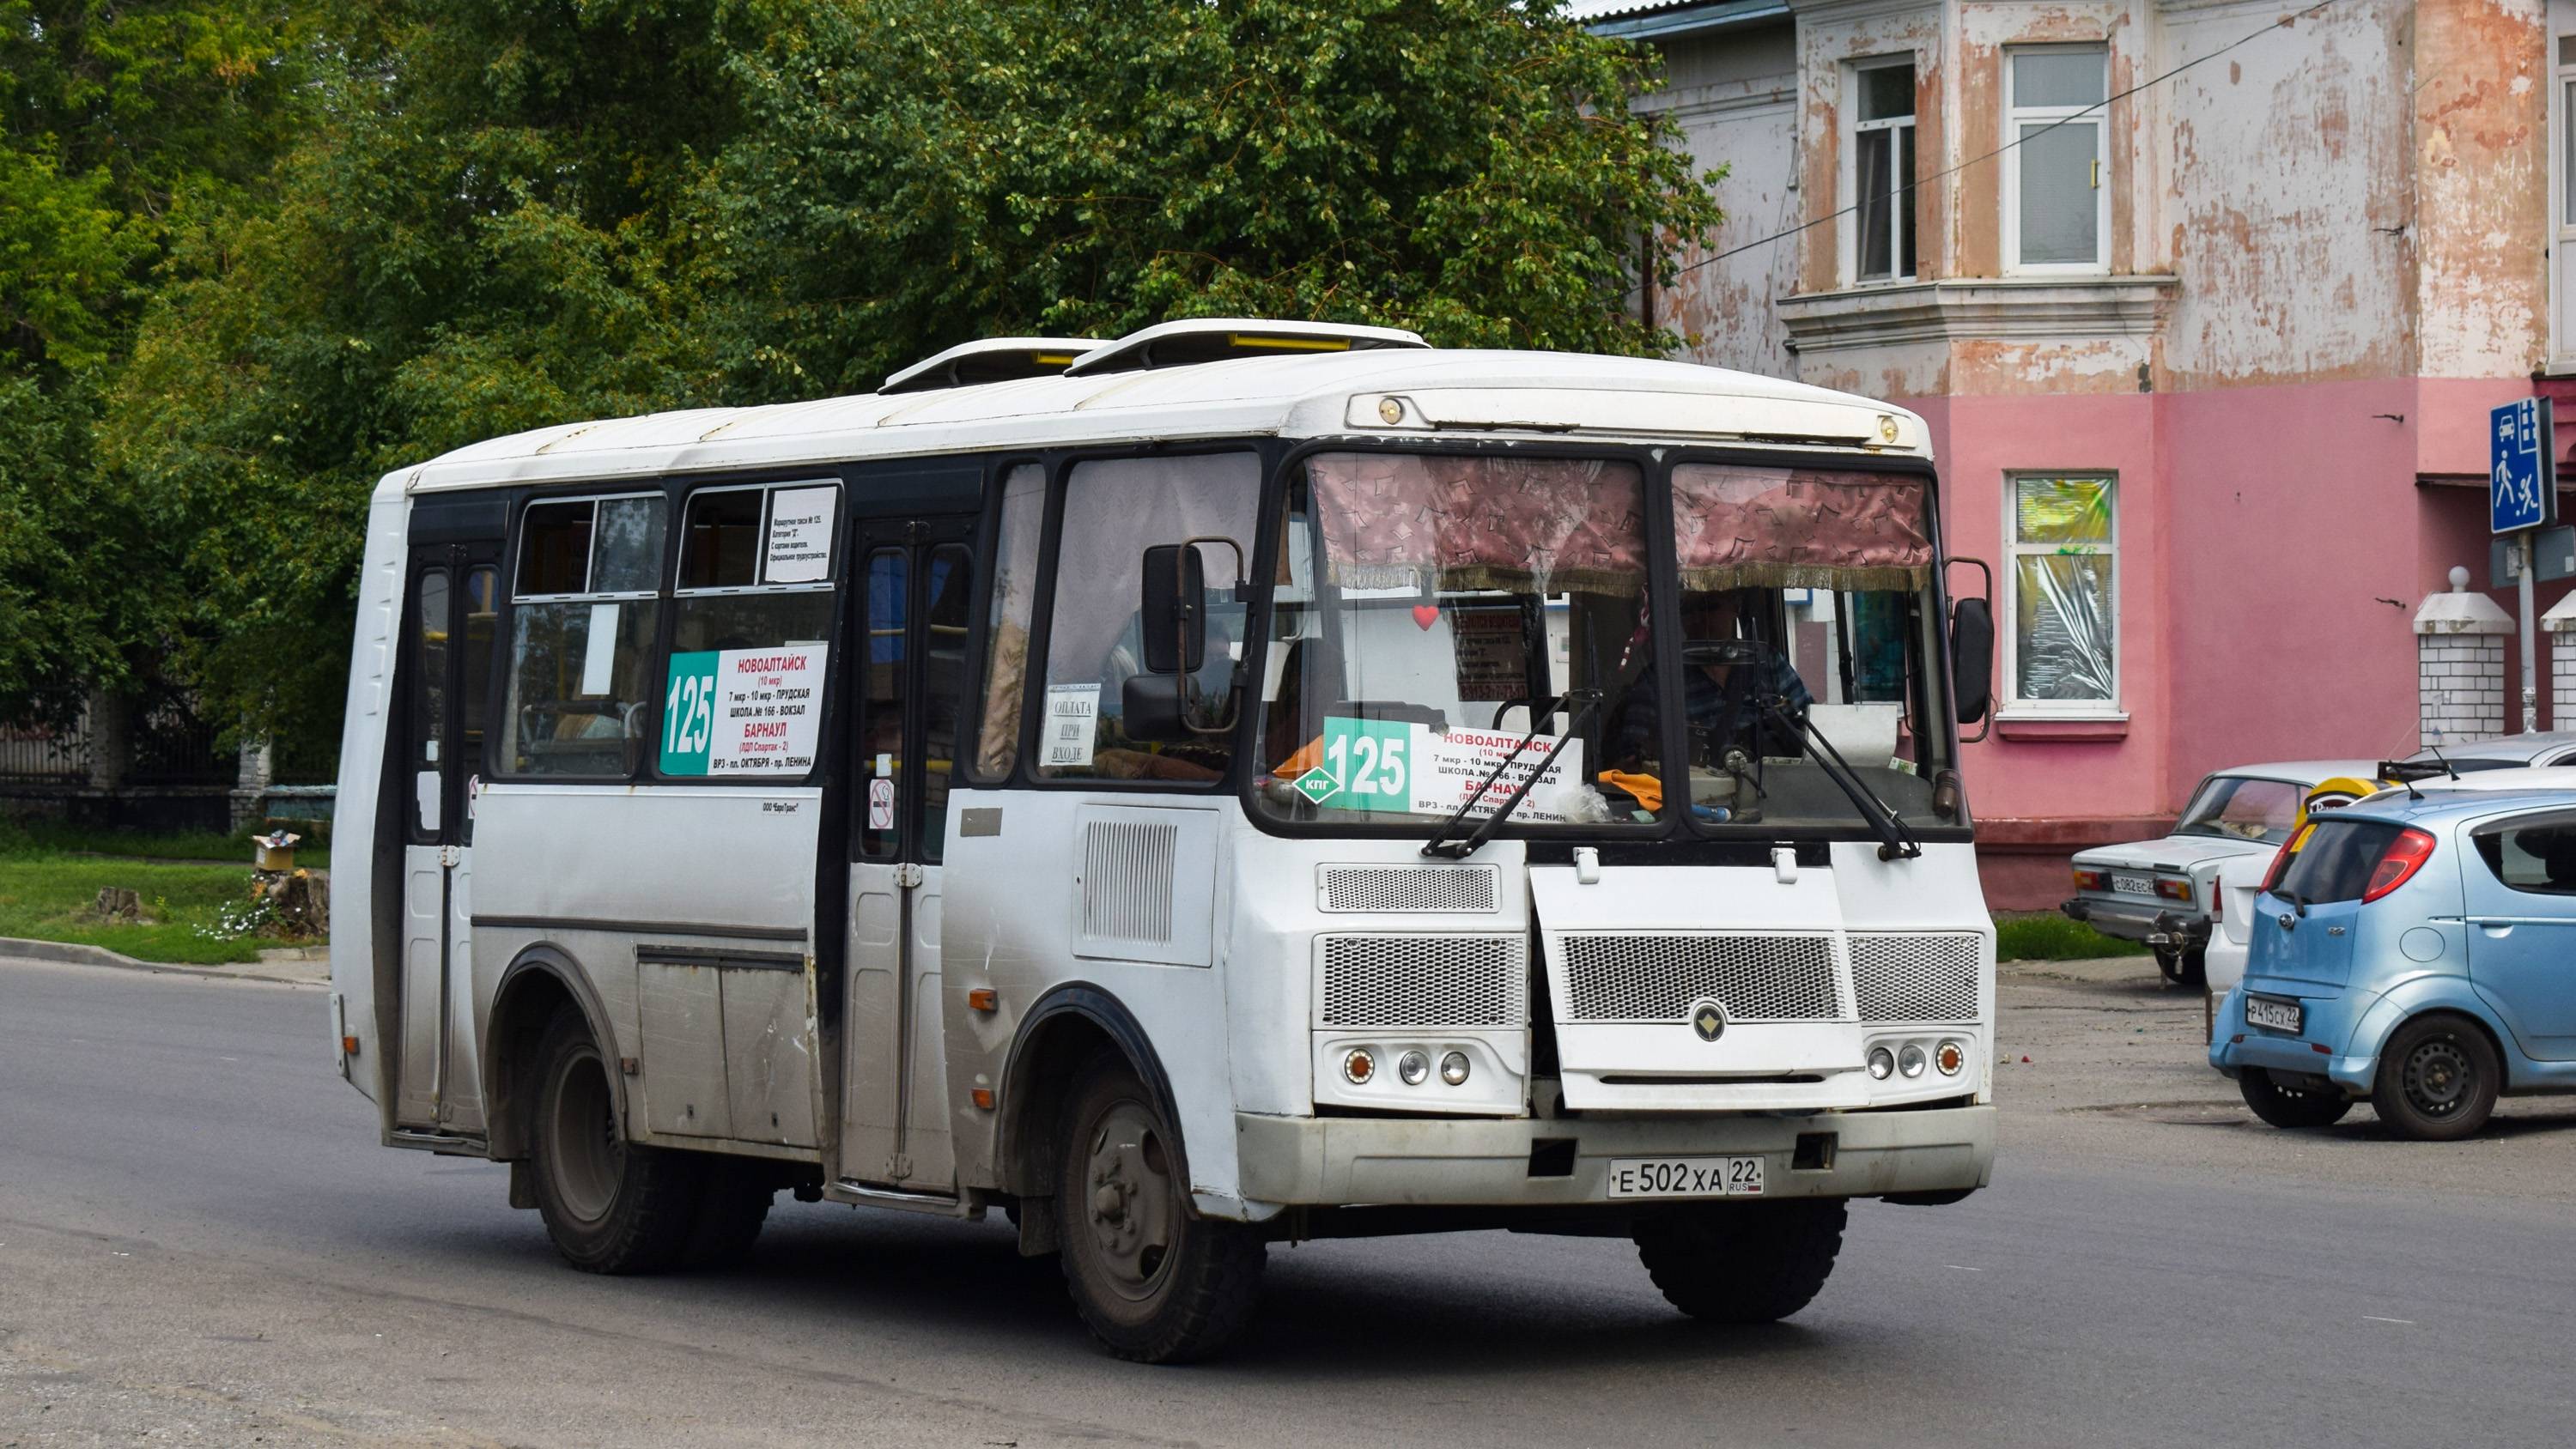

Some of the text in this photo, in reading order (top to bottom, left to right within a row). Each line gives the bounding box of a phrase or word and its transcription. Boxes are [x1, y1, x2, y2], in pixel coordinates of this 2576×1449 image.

[738, 653, 807, 673] НОВОАЛТАЙСК
[758, 675, 782, 688] (10 мкр)
[729, 691, 733, 701] 7
[734, 694, 746, 704] мкр
[750, 690, 759, 701] 10
[759, 693, 772, 703] мкр
[776, 688, 810, 701] ПРУДСКАЯ
[730, 707, 752, 718] ШКОЛА
[764, 706, 775, 717] 166
[780, 705, 805, 716] ВОКЗАЛ
[1054, 700, 1091, 714] ОПЛАТА
[668, 675, 714, 754] 125
[744, 722, 787, 738] БАРНАУЛ
[1060, 724, 1080, 737] ПРИ
[754, 742, 778, 754] Спартак
[782, 741, 788, 753] 2)
[1051, 747, 1084, 761] ВХОДЕ
[740, 757, 769, 767] ОКТЯБРЯ
[774, 759, 783, 769] пр.
[784, 756, 811, 767] ЛЕНИНА
[1327, 734, 1406, 796] 125
[1438, 766, 1474, 777] ШКОЛА
[1518, 773, 1556, 785] ВОЗАЛ
[1305, 779, 1330, 790] КПГ
[762, 803, 772, 811] ООО
[1527, 799, 1535, 809] 2)
[2287, 1008, 2297, 1022] 22
[1731, 1160, 1757, 1183] 22
[1728, 1183, 1748, 1192] RUS
